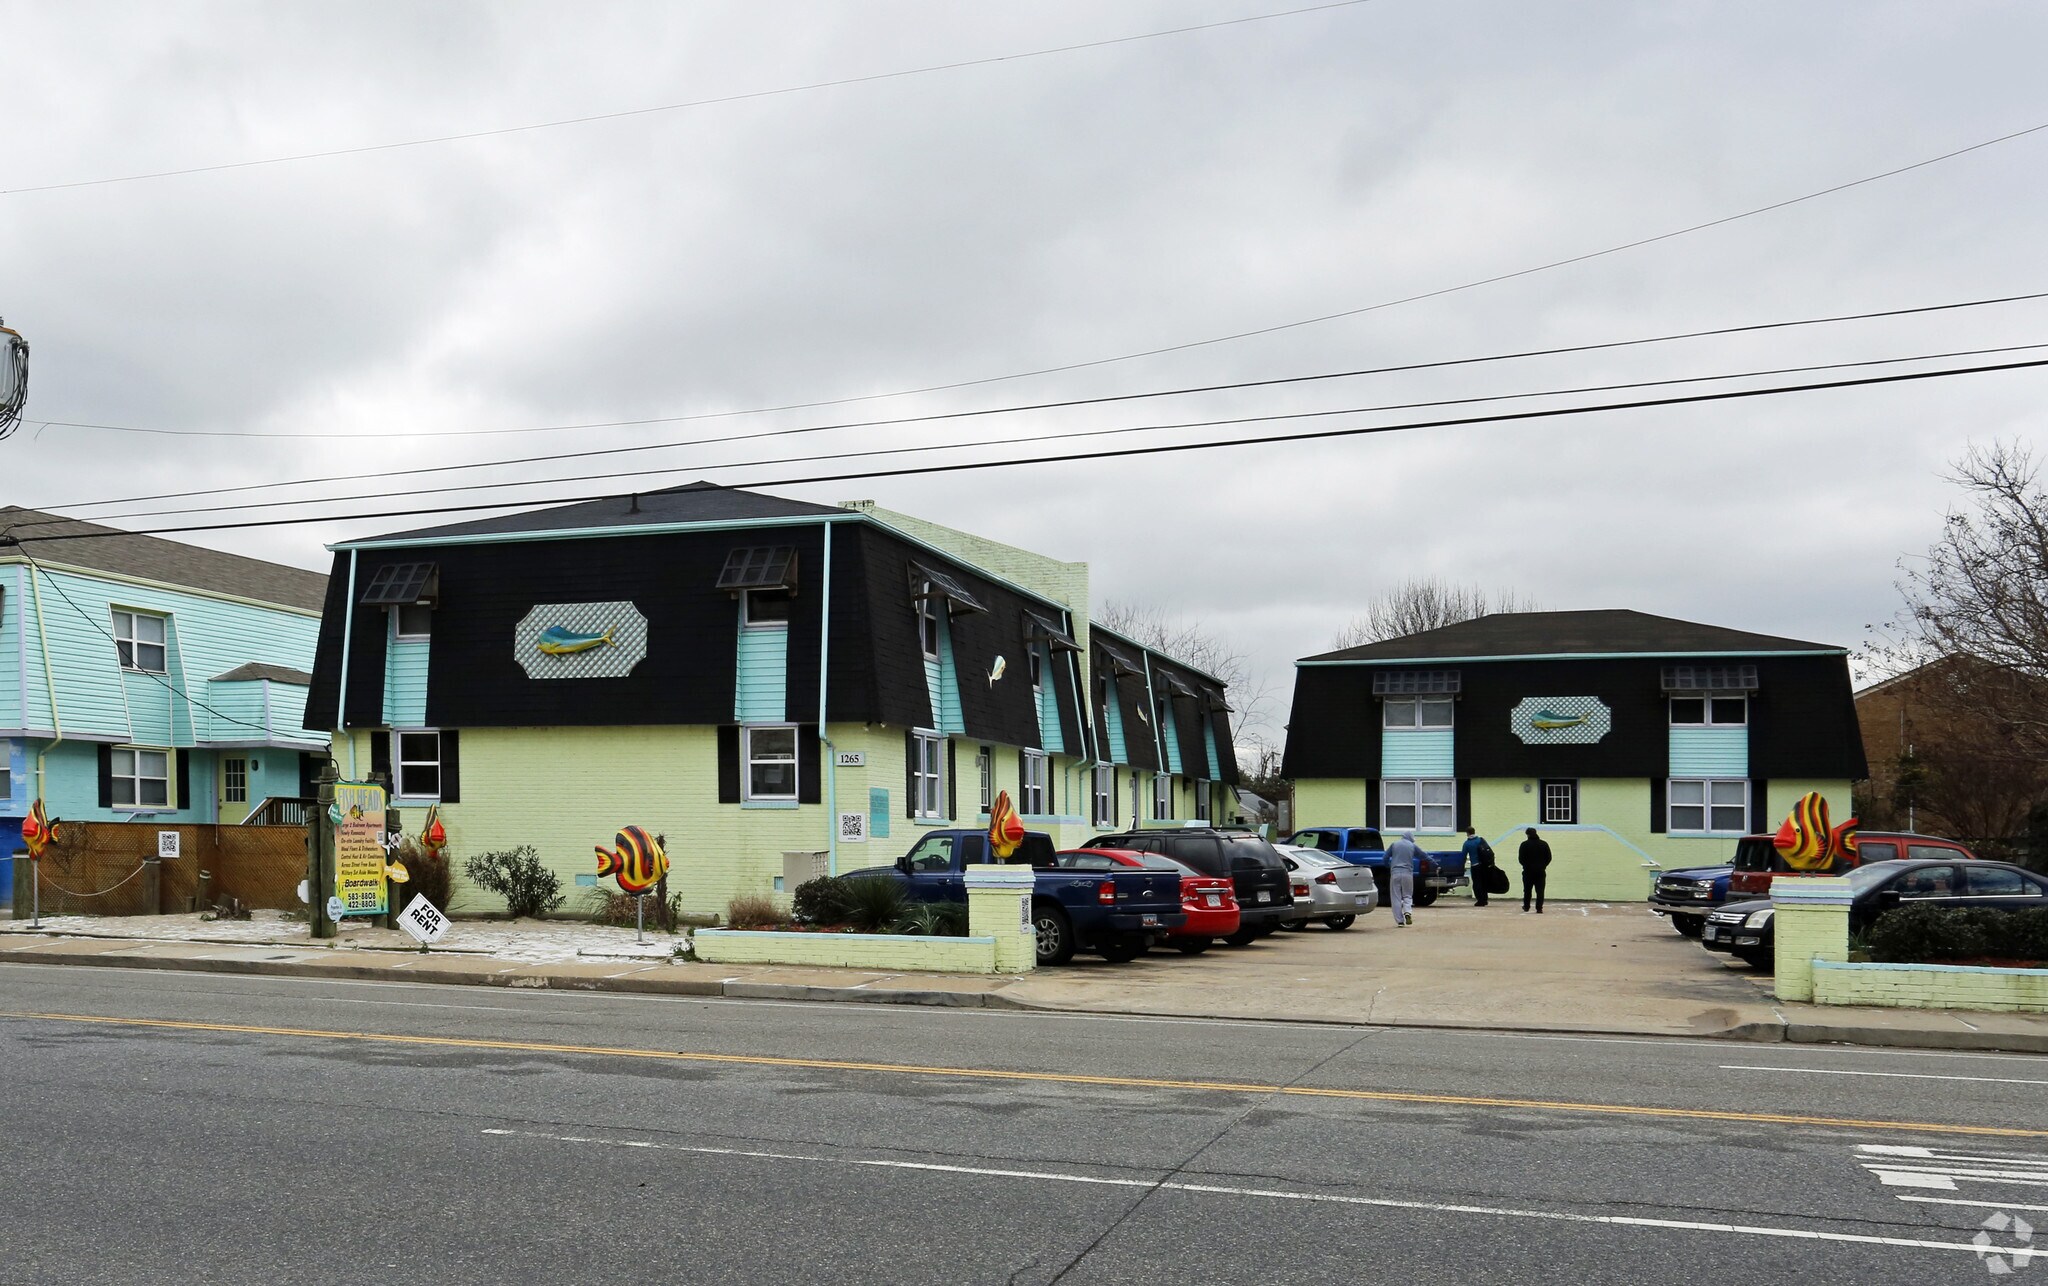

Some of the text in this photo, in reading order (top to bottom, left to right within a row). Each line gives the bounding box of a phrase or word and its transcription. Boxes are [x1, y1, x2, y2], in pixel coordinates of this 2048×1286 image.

[841, 754, 859, 763] 1265
[338, 788, 382, 812] FISH HEADS
[345, 878, 379, 887] Boardwalk
[348, 892, 376, 900] 583-8808
[348, 900, 376, 908] 422-8808
[420, 903, 441, 925] FOR
[410, 909, 438, 935] RENT
